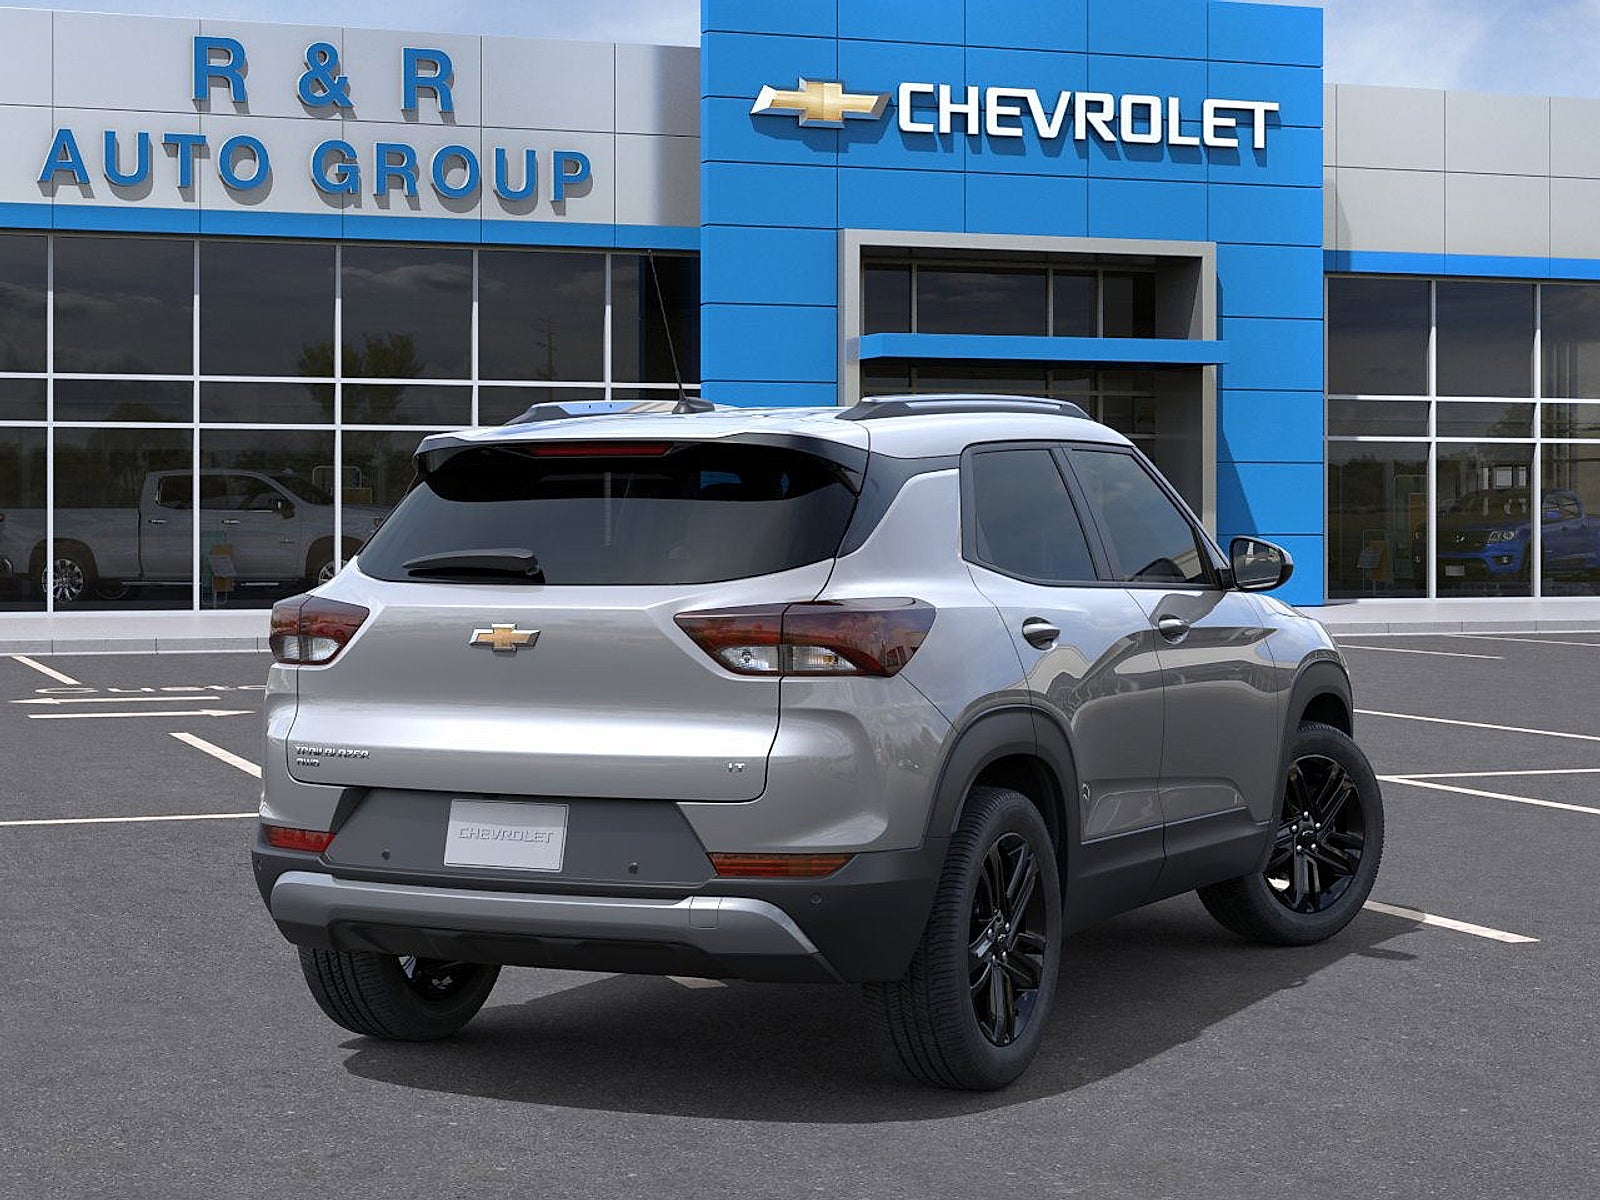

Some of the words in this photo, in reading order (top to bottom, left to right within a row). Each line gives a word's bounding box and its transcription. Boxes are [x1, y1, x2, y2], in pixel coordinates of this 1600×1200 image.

[192, 36, 247, 103] R
[297, 42, 353, 107] &
[402, 47, 454, 113] R
[897, 81, 1280, 149] CHEVROLET
[39, 128, 270, 191] AUTO
[312, 139, 592, 203] GROUP
[459, 827, 555, 843] CHEVROLET
